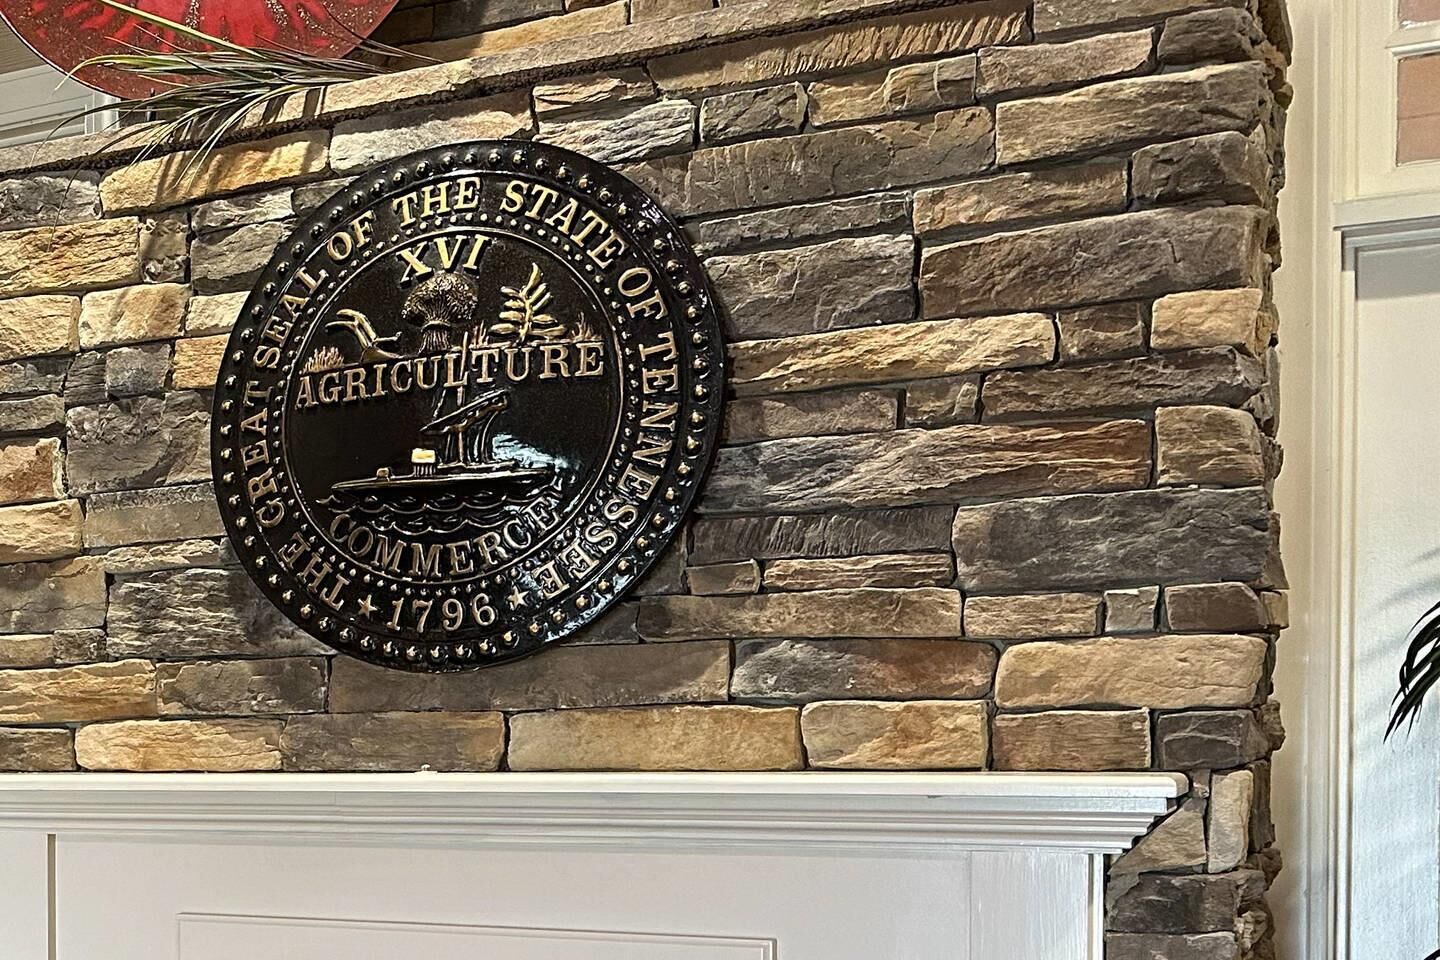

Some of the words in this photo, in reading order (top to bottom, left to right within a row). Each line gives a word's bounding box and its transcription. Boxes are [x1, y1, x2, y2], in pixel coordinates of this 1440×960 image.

[327, 213, 376, 262] OF
[392, 178, 480, 227] THE
[502, 179, 625, 269] STATE
[397, 237, 490, 283] XVI
[617, 266, 668, 323] OF
[253, 268, 327, 370] SEAL
[295, 342, 603, 408] AGRICULTURE
[240, 380, 284, 526] GREAT
[539, 330, 679, 598] TENNESSEE
[278, 532, 344, 610] THE
[328, 497, 562, 577] COMMERCE
[390, 593, 496, 633] 1796
